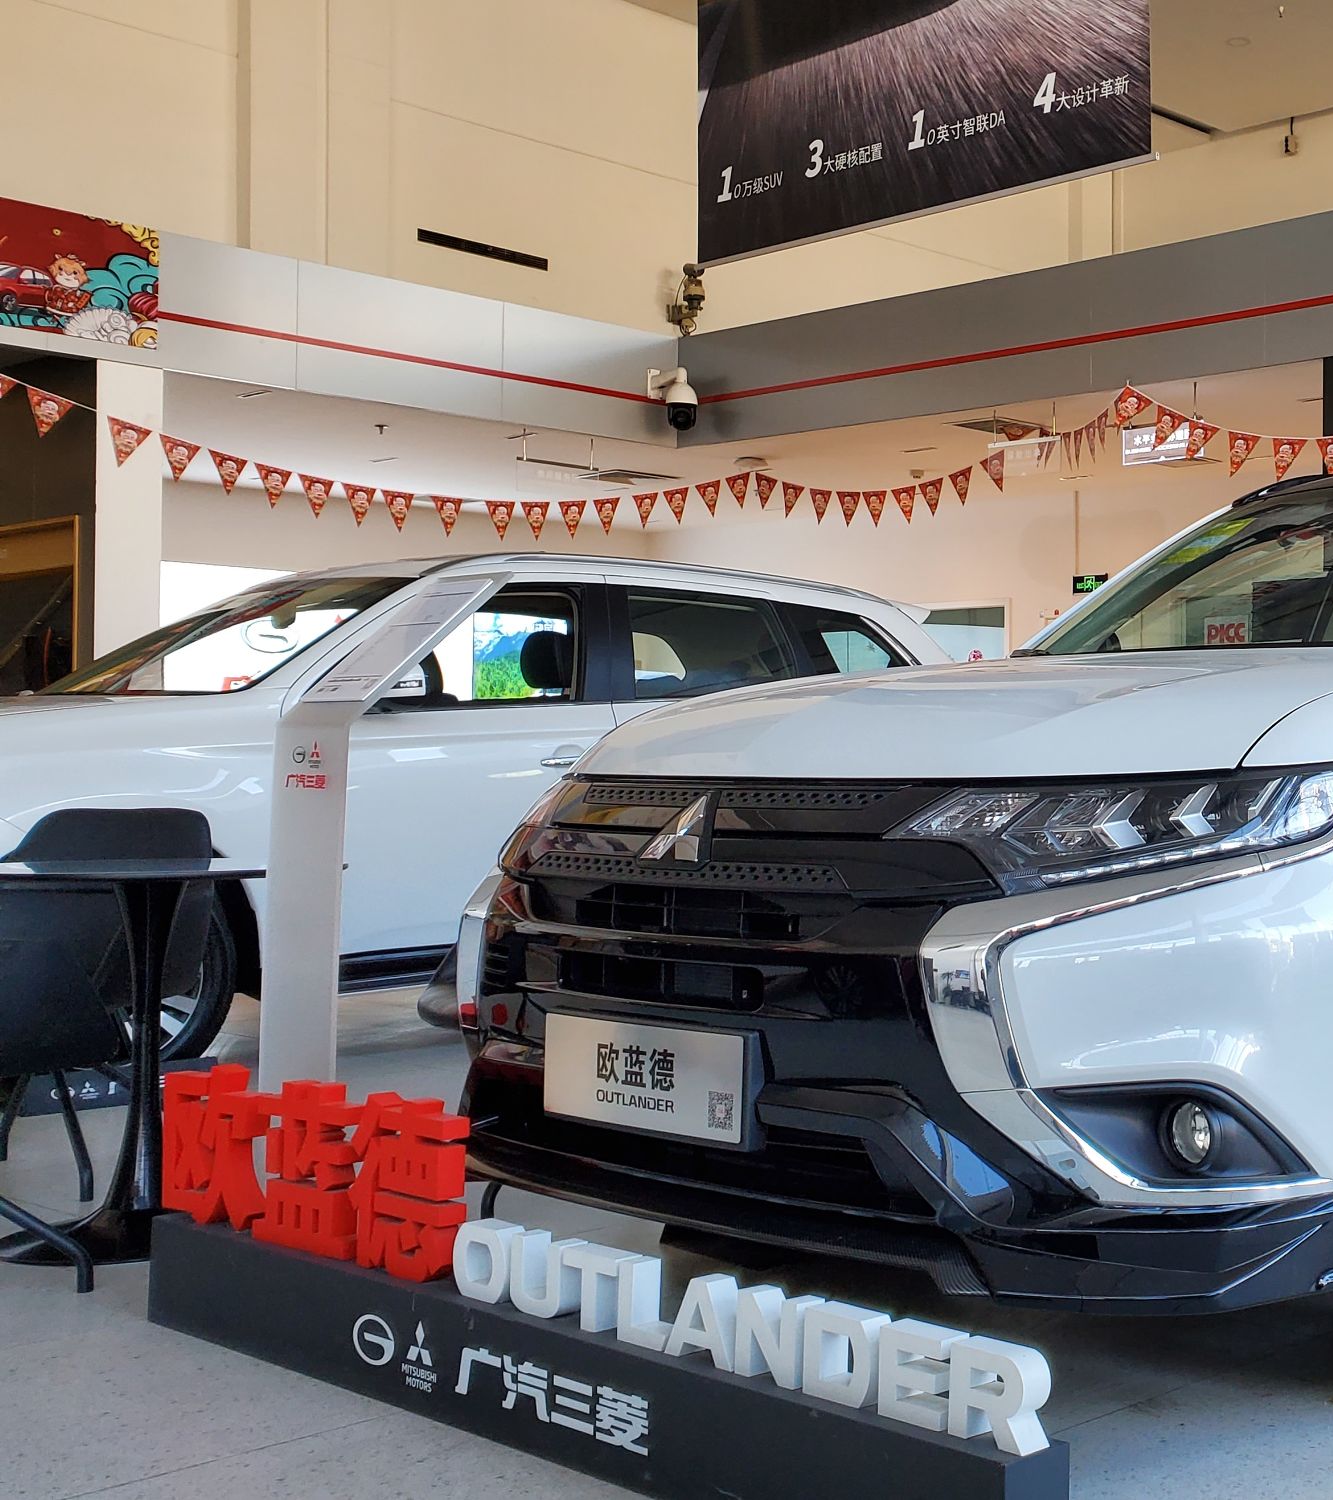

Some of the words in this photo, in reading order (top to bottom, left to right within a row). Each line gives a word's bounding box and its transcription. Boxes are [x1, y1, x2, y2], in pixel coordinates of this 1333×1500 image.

[805, 139, 883, 178] 3大硬核配置
[1033, 72, 1130, 114] 4大设计革新
[1207, 623, 1246, 644] PICC
[597, 1042, 675, 1092] 欧蓝德
[596, 1089, 675, 1114] OUTLANDER
[162, 1063, 471, 1282] 欧蓝德
[452, 1218, 1052, 1458] OUTLANDER
[401, 1362, 437, 1384] MITSUBISHI
[405, 1376, 433, 1394] MOTORS
[454, 1346, 649, 1457] 广汽三菱
